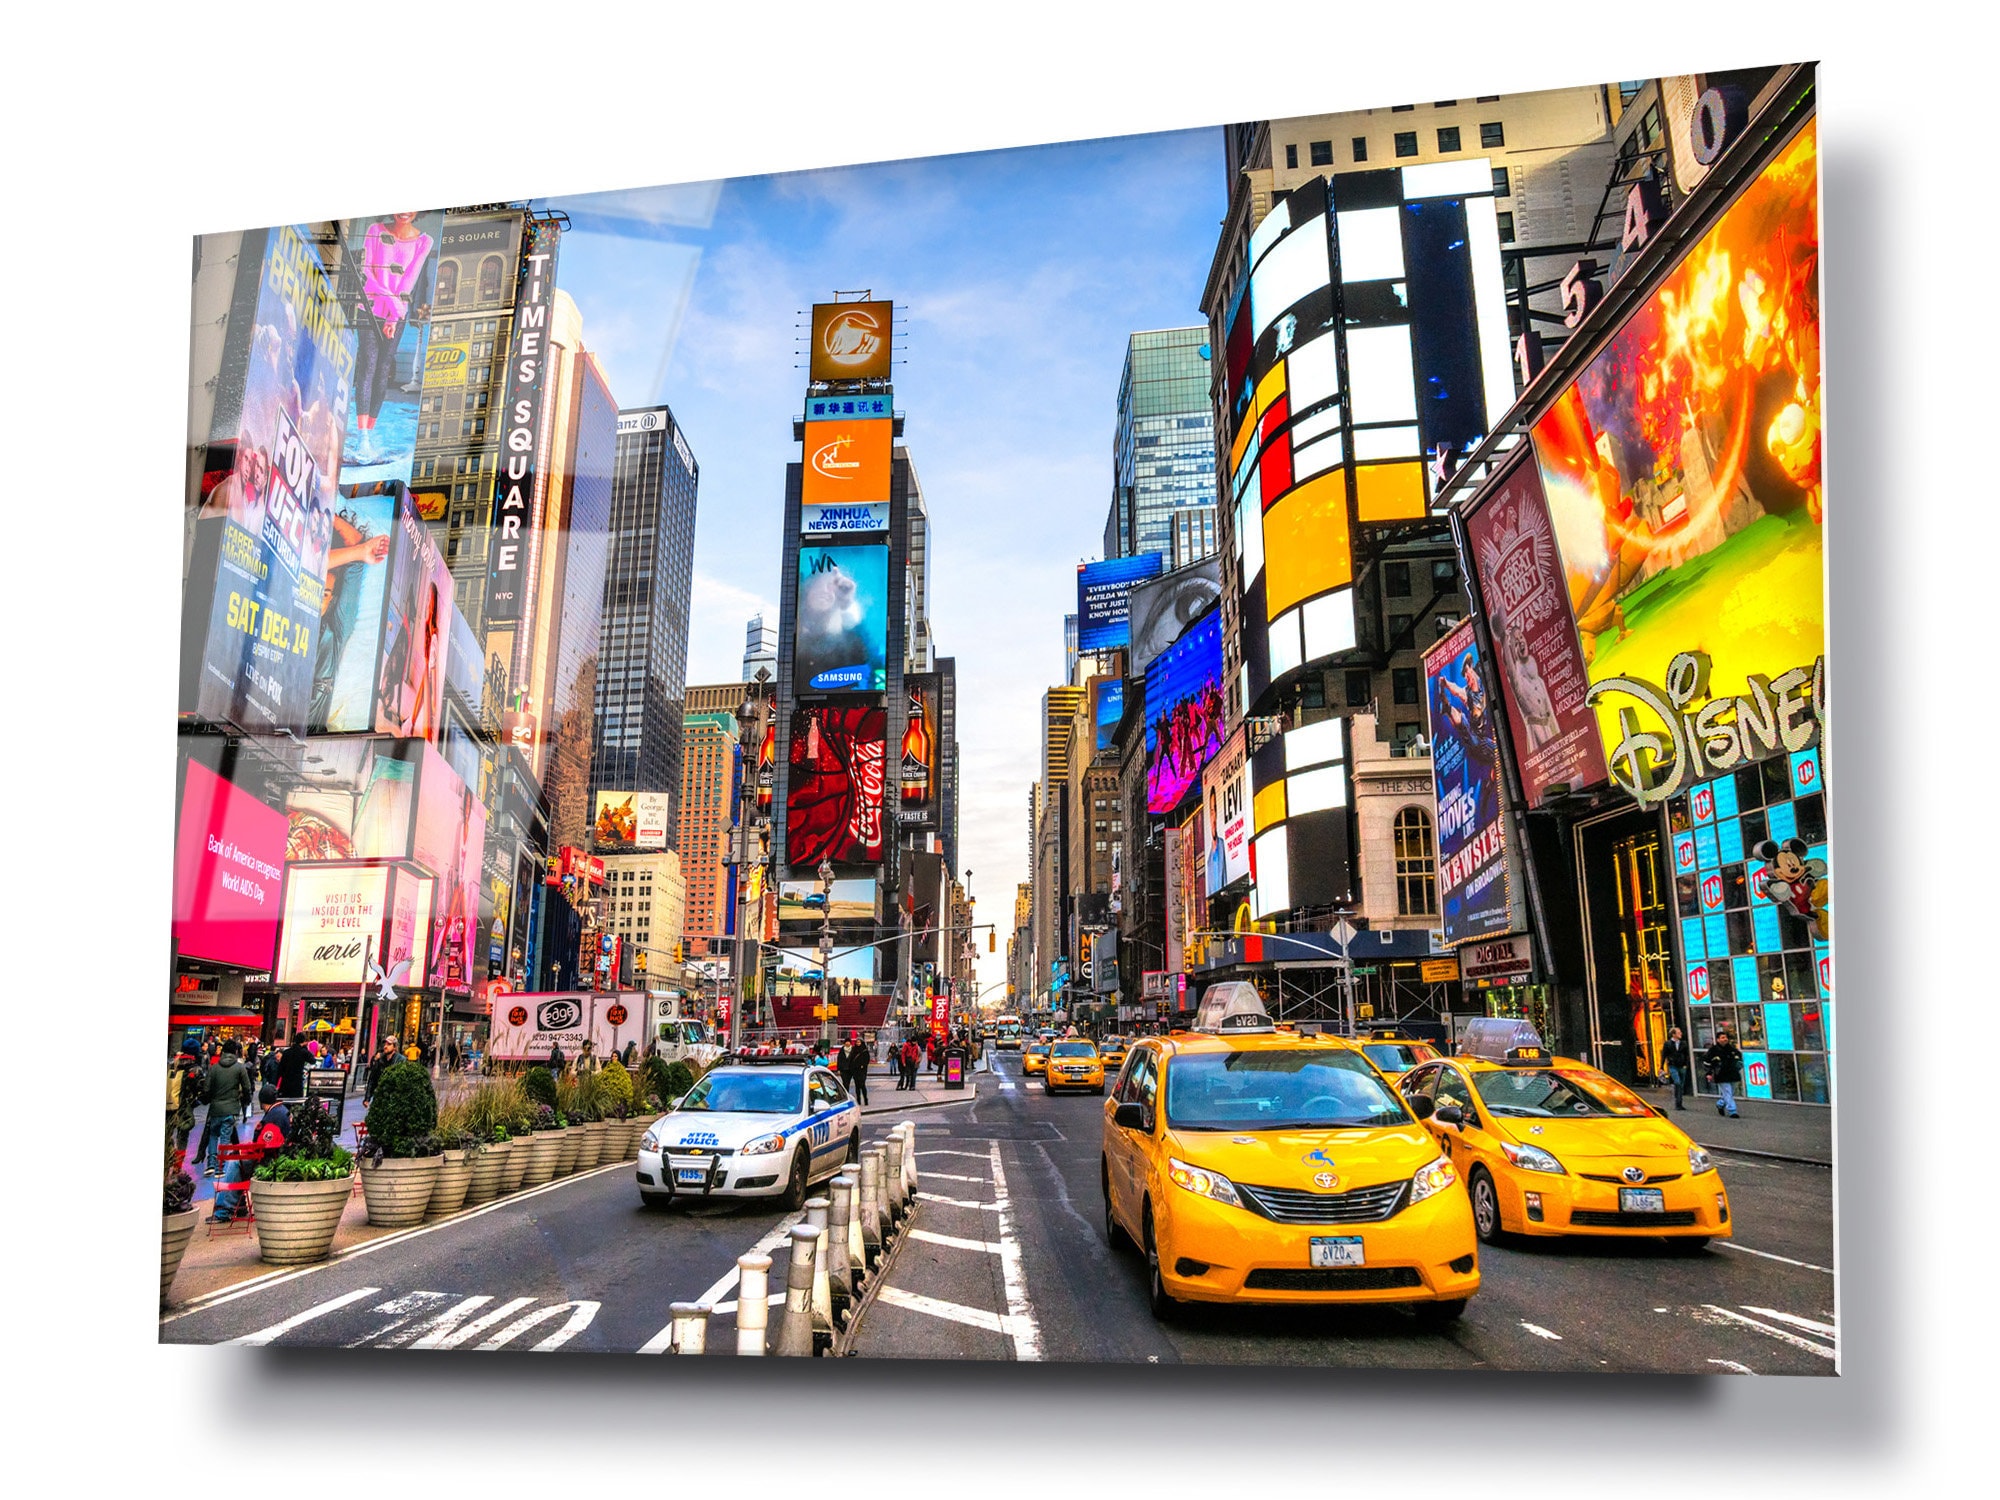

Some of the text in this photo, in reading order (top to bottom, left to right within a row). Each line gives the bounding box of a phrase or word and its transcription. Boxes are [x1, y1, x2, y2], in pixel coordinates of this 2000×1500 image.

[458, 230, 501, 243] SQUARE
[498, 254, 550, 571] TIMES SQUARE
[813, 400, 884, 415] 新华通讯社
[274, 416, 313, 513] FOX
[268, 476, 304, 548] UFC
[820, 508, 871, 520] XINHUA
[808, 519, 883, 530] NEWS AGENCY
[263, 518, 300, 575] SATURDAY
[495, 592, 513, 600] NYC
[1086, 592, 1116, 603] MATILDA
[1090, 600, 1125, 610] THEY JUST
[1089, 611, 1111, 619] KNOW
[226, 591, 259, 637] SAT.
[261, 608, 291, 651] DEC.
[292, 623, 310, 658] 14
[818, 673, 862, 682] SAMSUNG
[267, 675, 283, 706] FOX
[1380, 780, 1433, 792] THE SHO
[1223, 775, 1242, 824] LEVI
[1439, 786, 1476, 844] MOVES
[207, 833, 281, 881] Bank of America recognizes
[1440, 815, 1506, 896] NEWSIES
[222, 870, 241, 892] World
[240, 878, 254, 897] AIDS
[325, 893, 362, 904] VISIT US
[311, 904, 373, 916] INSIDE ON THE
[336, 917, 361, 928] LEVEL
[313, 937, 361, 961] aerie
[1475, 943, 1515, 963] DIGITAL
[1638, 951, 1670, 962] MAC
[1510, 975, 1528, 984] SONY
[545, 1007, 574, 1022] edge
[720, 1000, 729, 1019] tkts
[936, 998, 947, 1020] tkts
[548, 1033, 583, 1042] 947-3343
[1517, 1048, 1539, 1058] 7L66
[679, 1137, 719, 1146] POLICE
[679, 1169, 700, 1180] 4135
